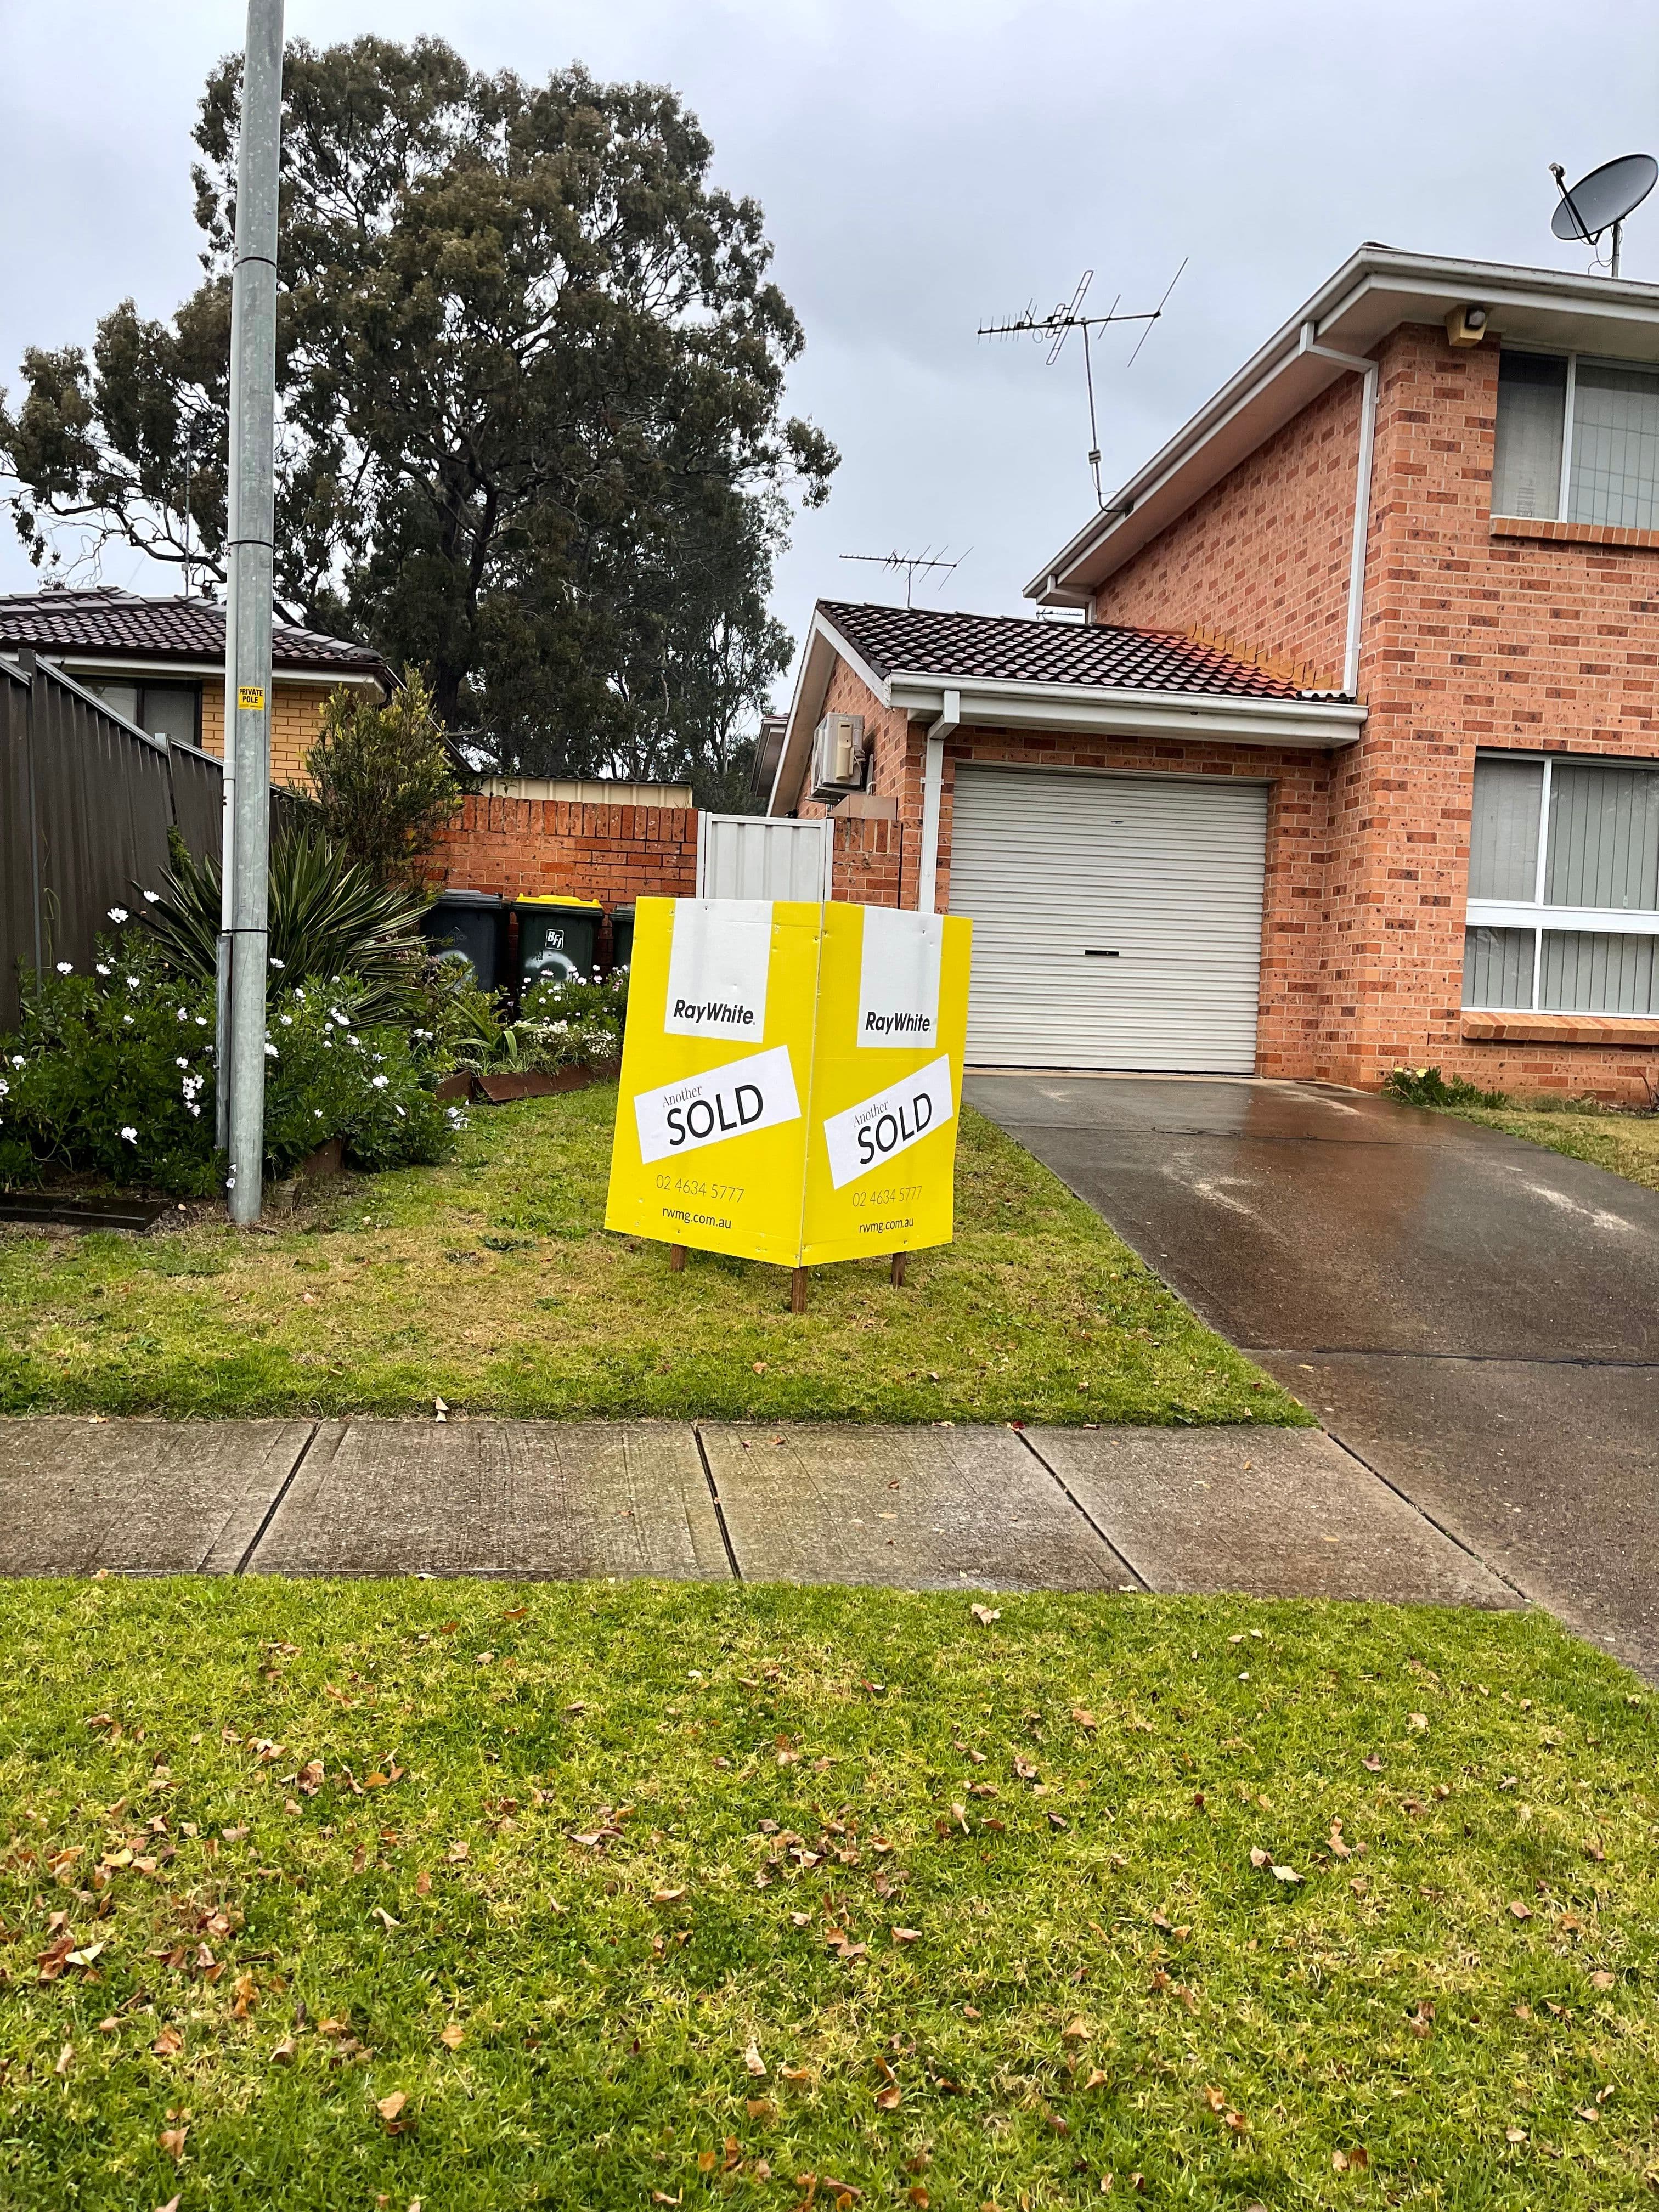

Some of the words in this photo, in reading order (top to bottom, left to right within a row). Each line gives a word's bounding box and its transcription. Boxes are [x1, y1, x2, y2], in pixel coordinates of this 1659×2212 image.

[548, 931, 562, 948] BFI
[663, 1086, 702, 1108] Another
[667, 1084, 763, 1146] SOLD
[854, 1101, 888, 1128] Another
[857, 1093, 932, 1165] SOLD
[656, 1174, 672, 1190] 02
[675, 1178, 707, 1197] 4634
[710, 1184, 744, 1203] 5777
[853, 1192, 867, 1207] 02
[870, 1189, 896, 1205] 4634
[899, 1186, 922, 1202] 5777
[662, 1207, 731, 1229] rwmg.com.au
[859, 1218, 914, 1234] rwmg.com.au
